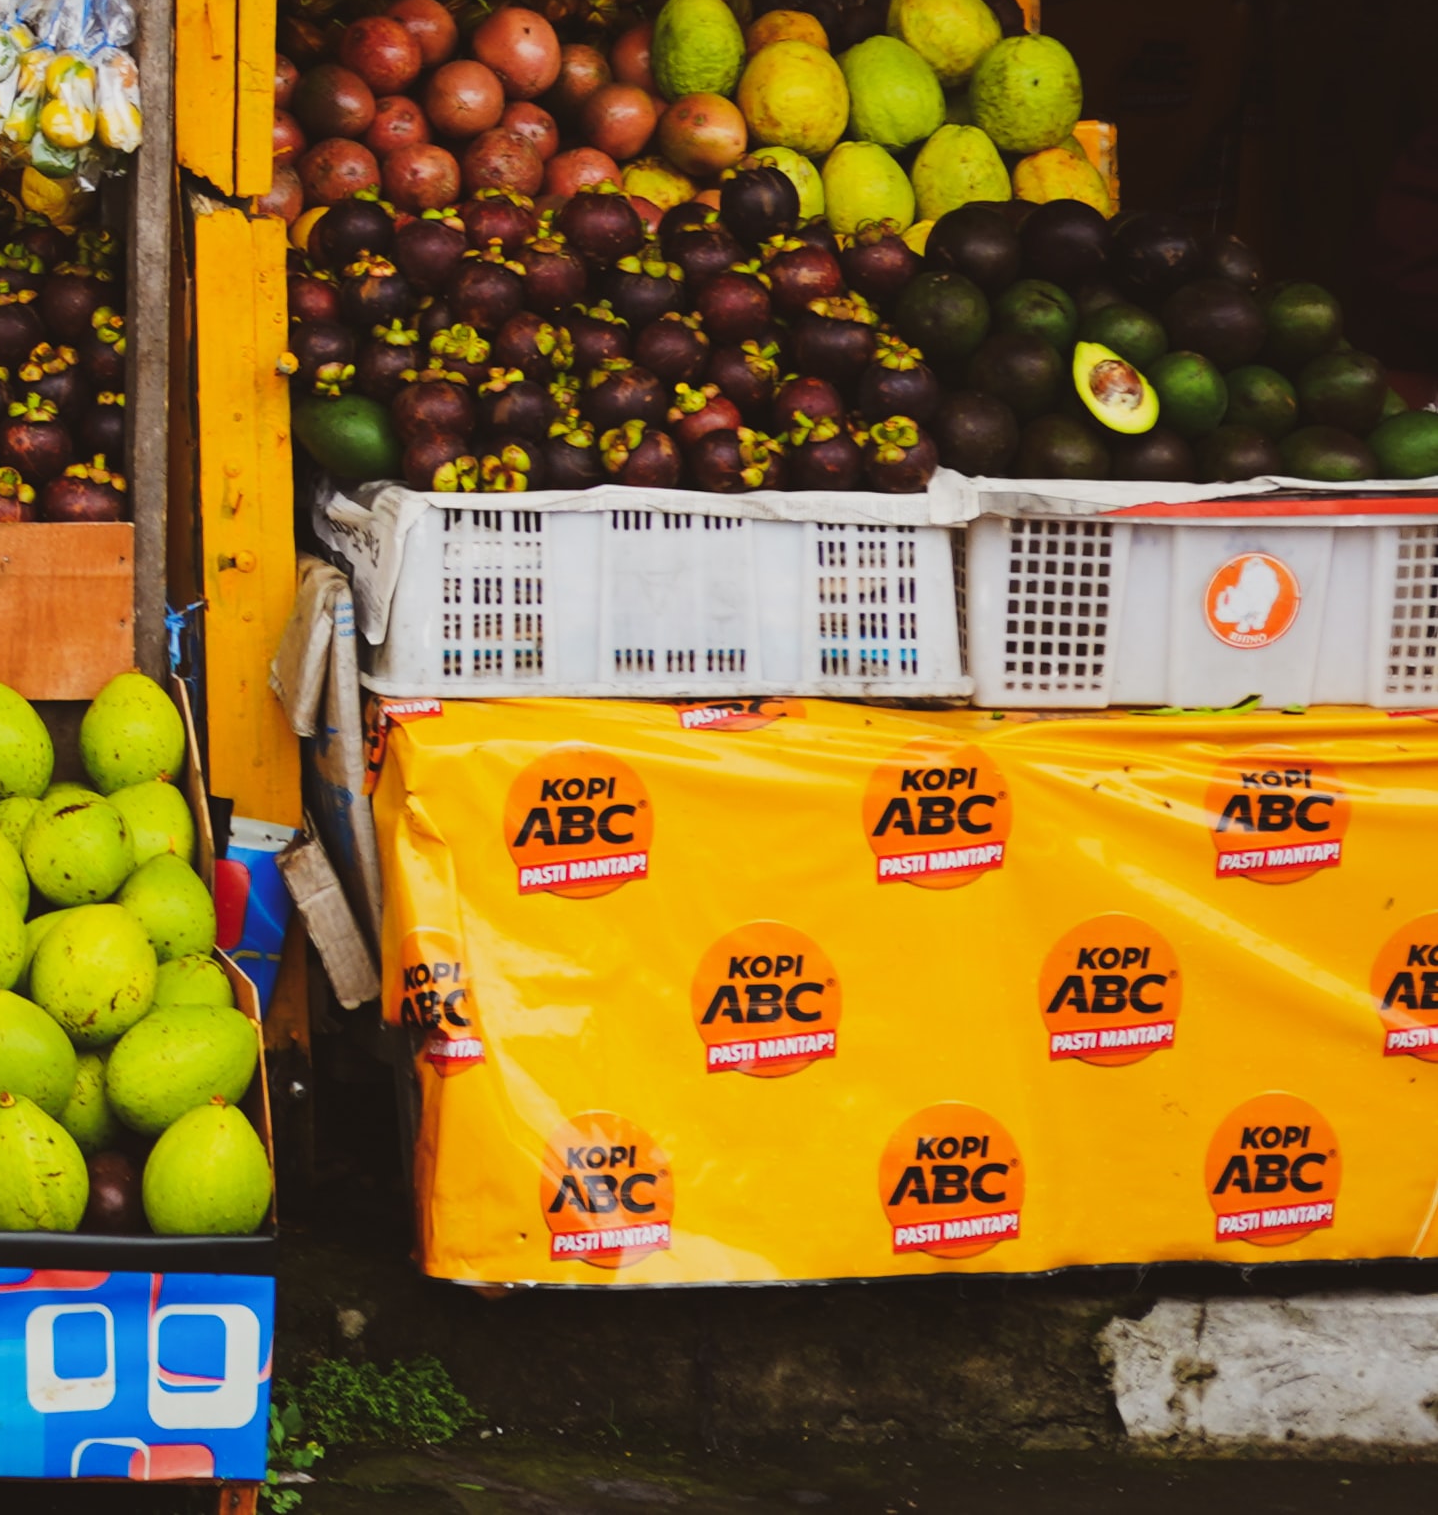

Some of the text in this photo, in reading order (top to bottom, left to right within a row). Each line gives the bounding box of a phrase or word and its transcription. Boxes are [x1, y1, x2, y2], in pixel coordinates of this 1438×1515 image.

[540, 777, 615, 801] KOPI
[900, 767, 975, 791] KOPI
[1241, 768, 1311, 790] KOPI
[513, 804, 637, 846] ABC
[872, 795, 997, 836] ABC
[1215, 795, 1334, 833] ABC
[520, 854, 646, 887] PASTI MANTAP!
[880, 845, 1002, 877] PASTI MANTAP!
[1220, 843, 1339, 872] PASTI MANTAP!
[729, 955, 803, 978] KOPI
[1076, 946, 1149, 970] KOPI
[403, 962, 461, 991] KOPI
[700, 983, 825, 1024] ABC
[1046, 973, 1167, 1014] ABC
[709, 1032, 834, 1064] PASTI MANTAP!
[1052, 1023, 1173, 1053] PASTI MANTAP!
[916, 1135, 988, 1160] KOPI
[1241, 1125, 1310, 1149] KOPI
[566, 1146, 636, 1169] KOPI
[888, 1163, 1009, 1206] ABC
[1213, 1154, 1326, 1194] ABC
[548, 1173, 657, 1213] ABC
[895, 1213, 1018, 1246] PASTI MANTAP!
[1219, 1203, 1332, 1235] PASTI MANTAP!
[554, 1223, 669, 1252] PASTI MANTAP!
